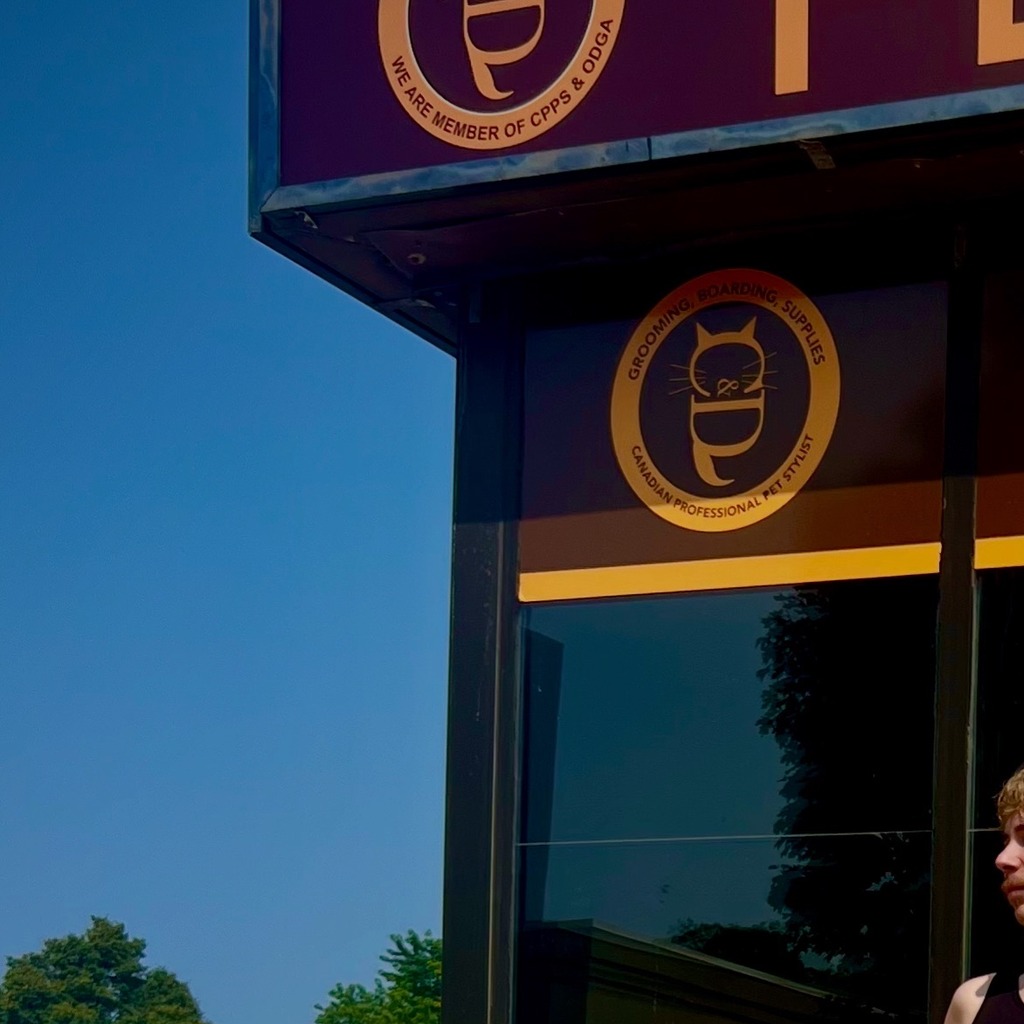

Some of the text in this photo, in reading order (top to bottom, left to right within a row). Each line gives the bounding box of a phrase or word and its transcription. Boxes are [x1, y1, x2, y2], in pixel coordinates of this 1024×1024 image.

[392, 18, 614, 141] WE ARE MEMBER OF CPPS & ODGA
[628, 282, 826, 382] GROOMING, BOARDING, SUPPLIES
[631, 434, 815, 519] CANADIAN PROFESSIONAL PET STYLIST
